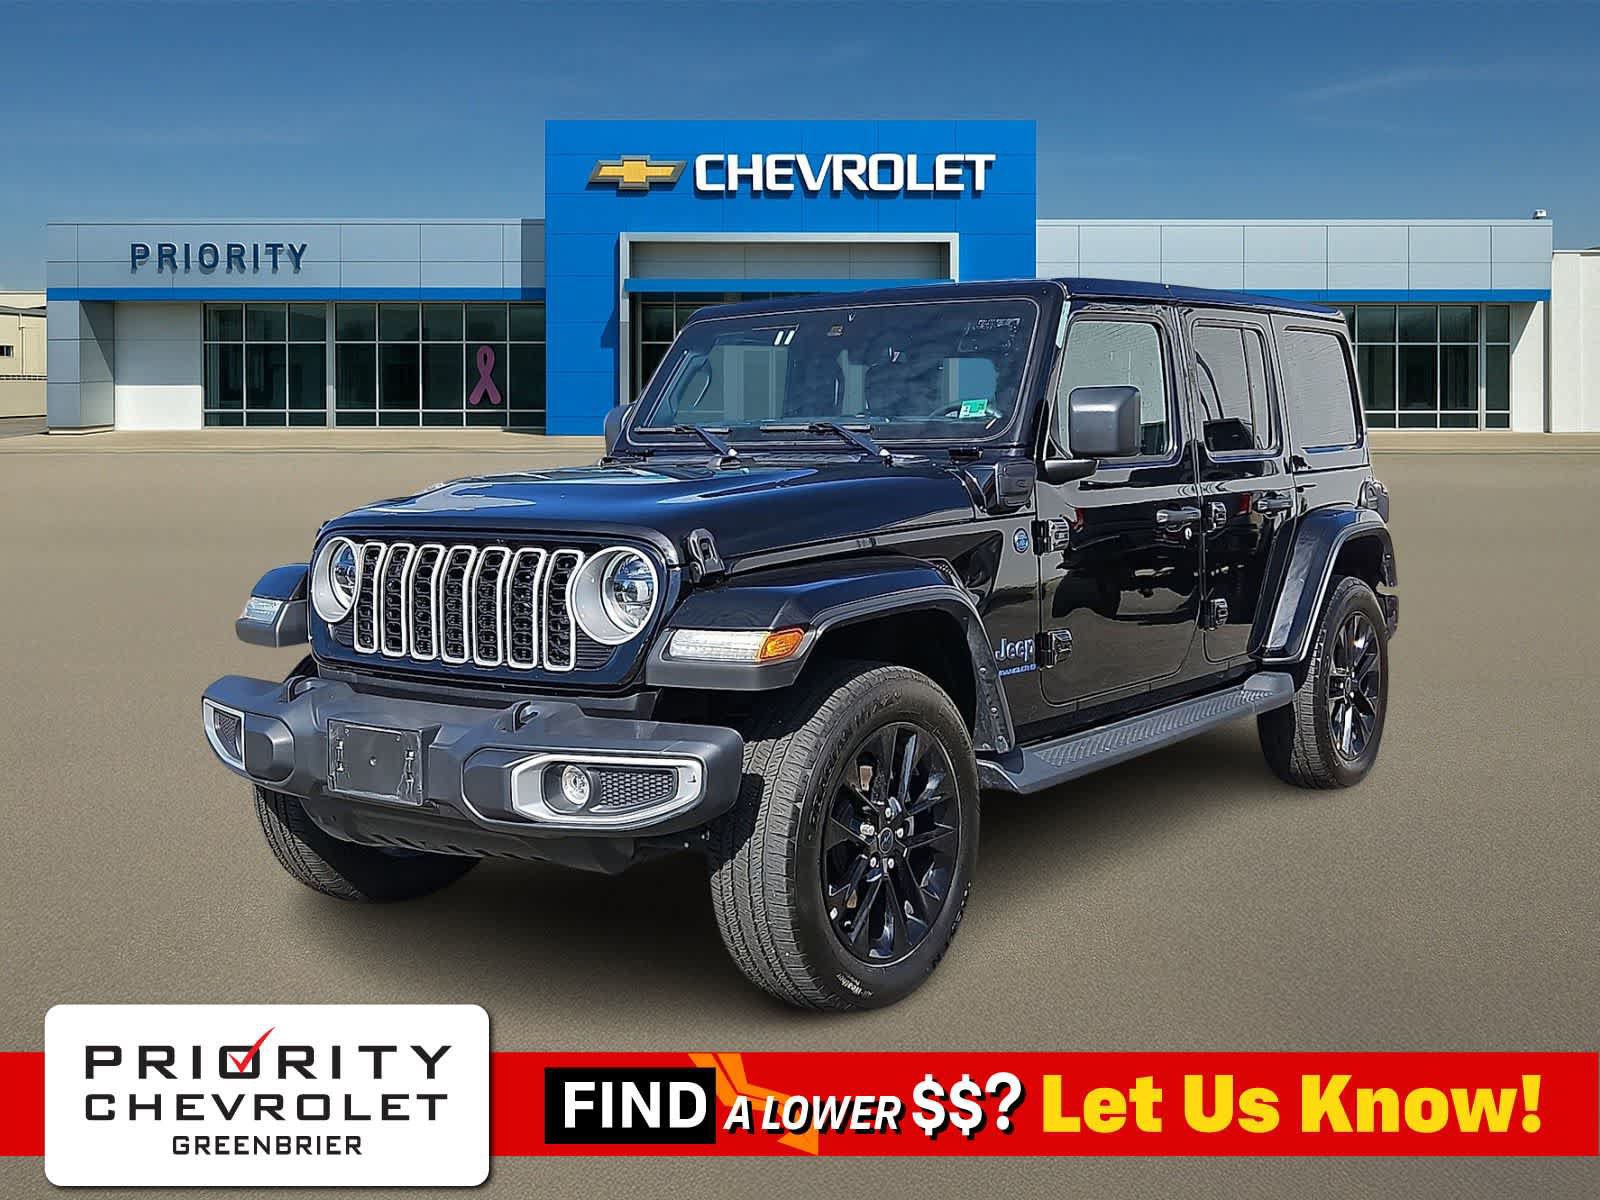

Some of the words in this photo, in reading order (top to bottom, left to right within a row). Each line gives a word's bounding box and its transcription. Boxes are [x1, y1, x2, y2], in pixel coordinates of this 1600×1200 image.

[696, 154, 995, 190] CHEVROLET
[130, 242, 308, 273] PRIORITY
[995, 638, 1036, 662] Jeep
